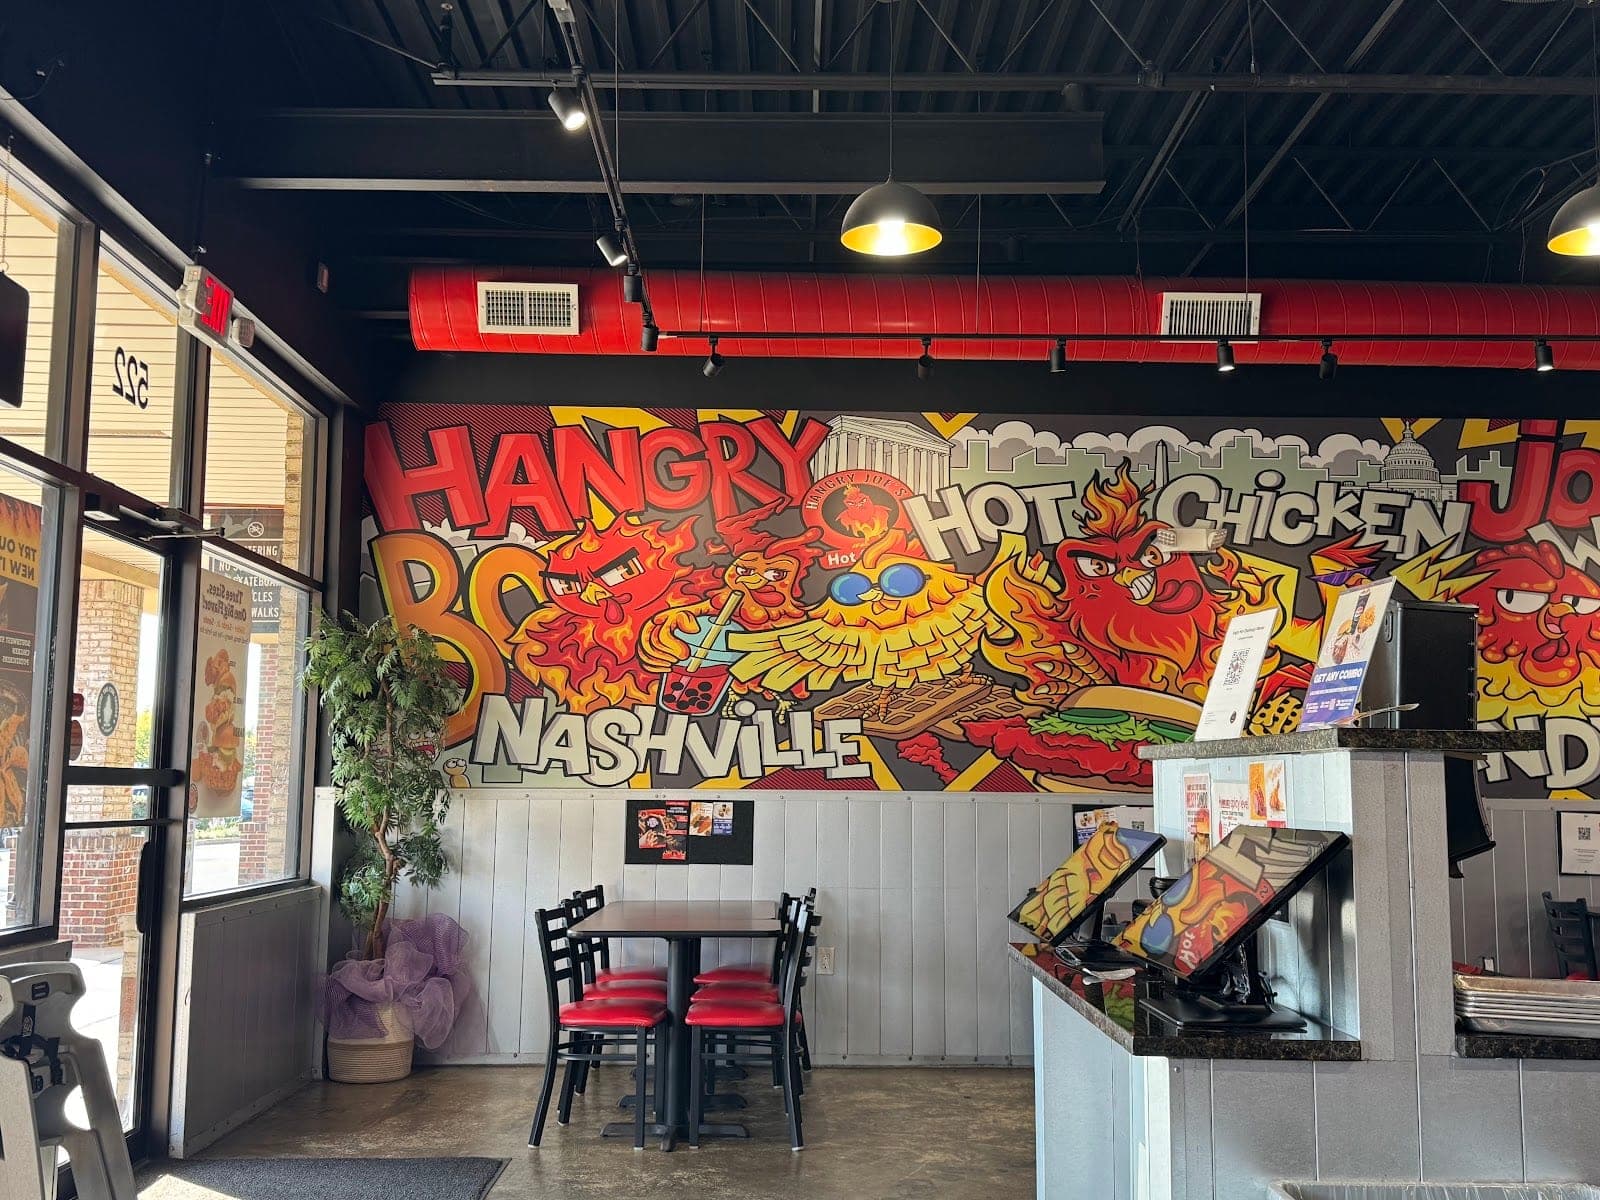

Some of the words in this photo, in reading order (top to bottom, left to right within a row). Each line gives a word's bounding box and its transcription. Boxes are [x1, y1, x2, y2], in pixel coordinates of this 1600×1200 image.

[364, 416, 829, 538] HANGRY
[806, 473, 856, 510] HANGRY
[864, 474, 908, 496] JOE'S
[902, 480, 1076, 562] HOT
[827, 552, 857, 566] Hot
[251, 590, 273, 602] CLES
[1313, 672, 1327, 684] GET
[1325, 670, 1341, 682] ANY
[1339, 668, 1363, 680] COMBO
[1177, 929, 1197, 970] Hot
